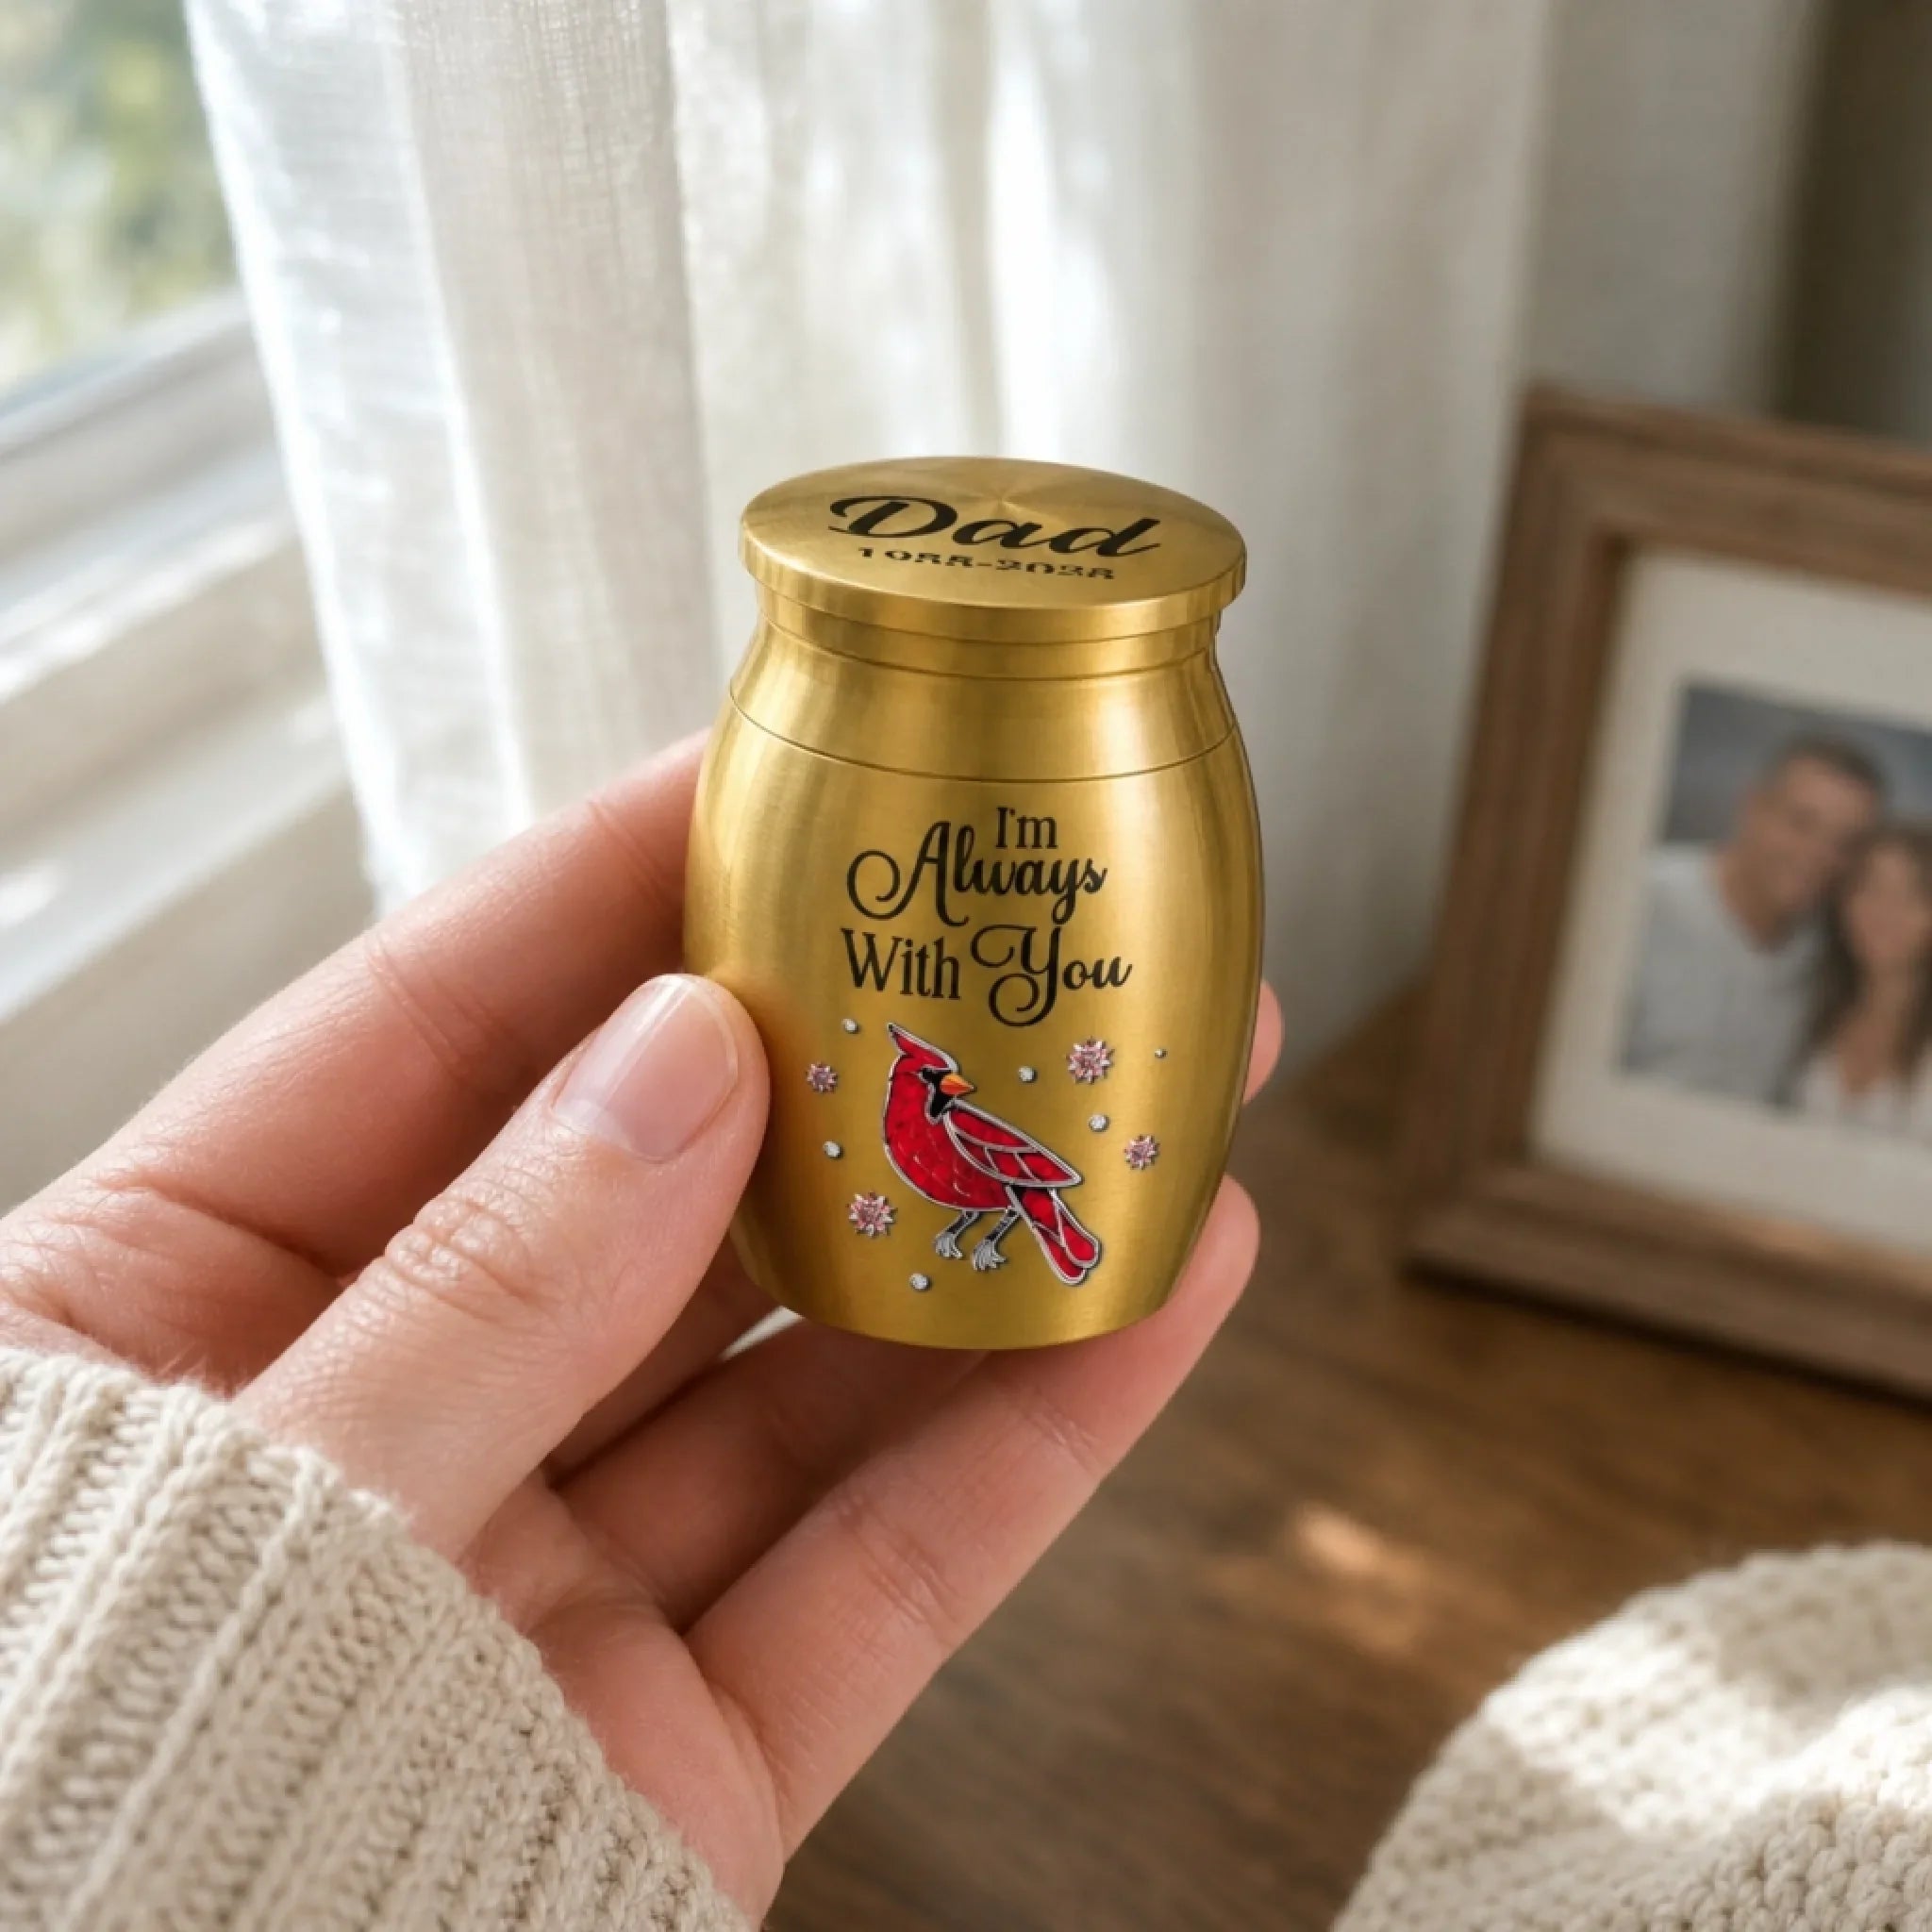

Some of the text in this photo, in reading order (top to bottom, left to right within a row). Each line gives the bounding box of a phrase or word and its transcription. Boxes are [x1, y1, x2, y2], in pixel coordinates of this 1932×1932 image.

[828, 495, 1161, 558] Dad
[995, 807, 1058, 849] I'm
[846, 820, 1108, 927] Always
[841, 924, 1133, 1027] With You
